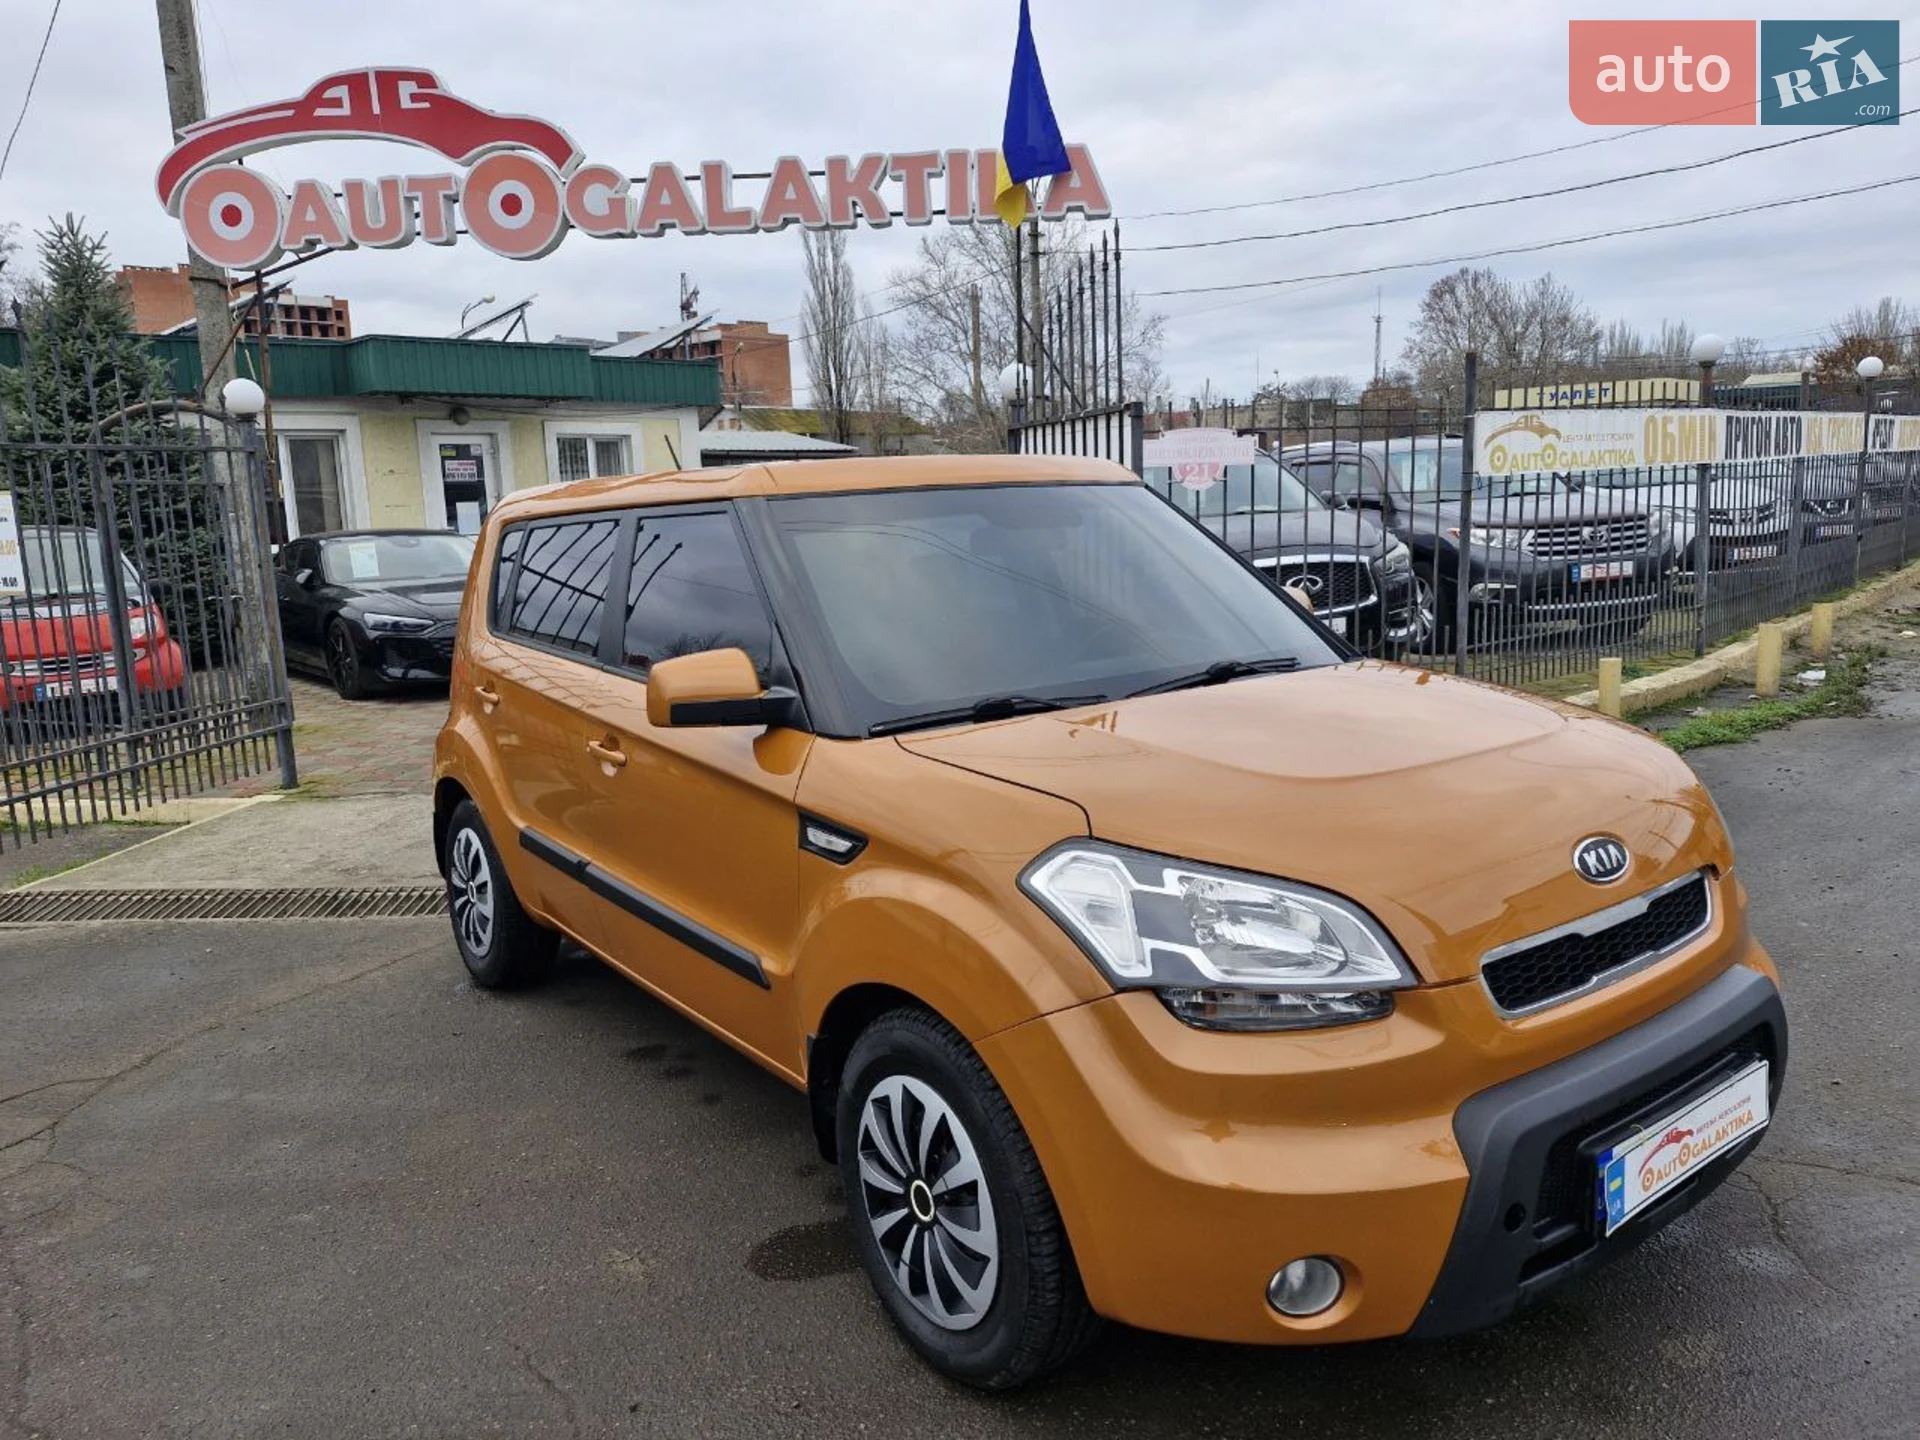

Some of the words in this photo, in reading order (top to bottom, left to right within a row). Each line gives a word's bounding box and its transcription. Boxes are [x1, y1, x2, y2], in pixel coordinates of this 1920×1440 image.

[1537, 387, 1611, 402] ТУАЛЕТ
[1724, 415, 1772, 460] ПРИГОН
[1774, 415, 1803, 457] АВТО
[1582, 843, 1624, 875] KIA
